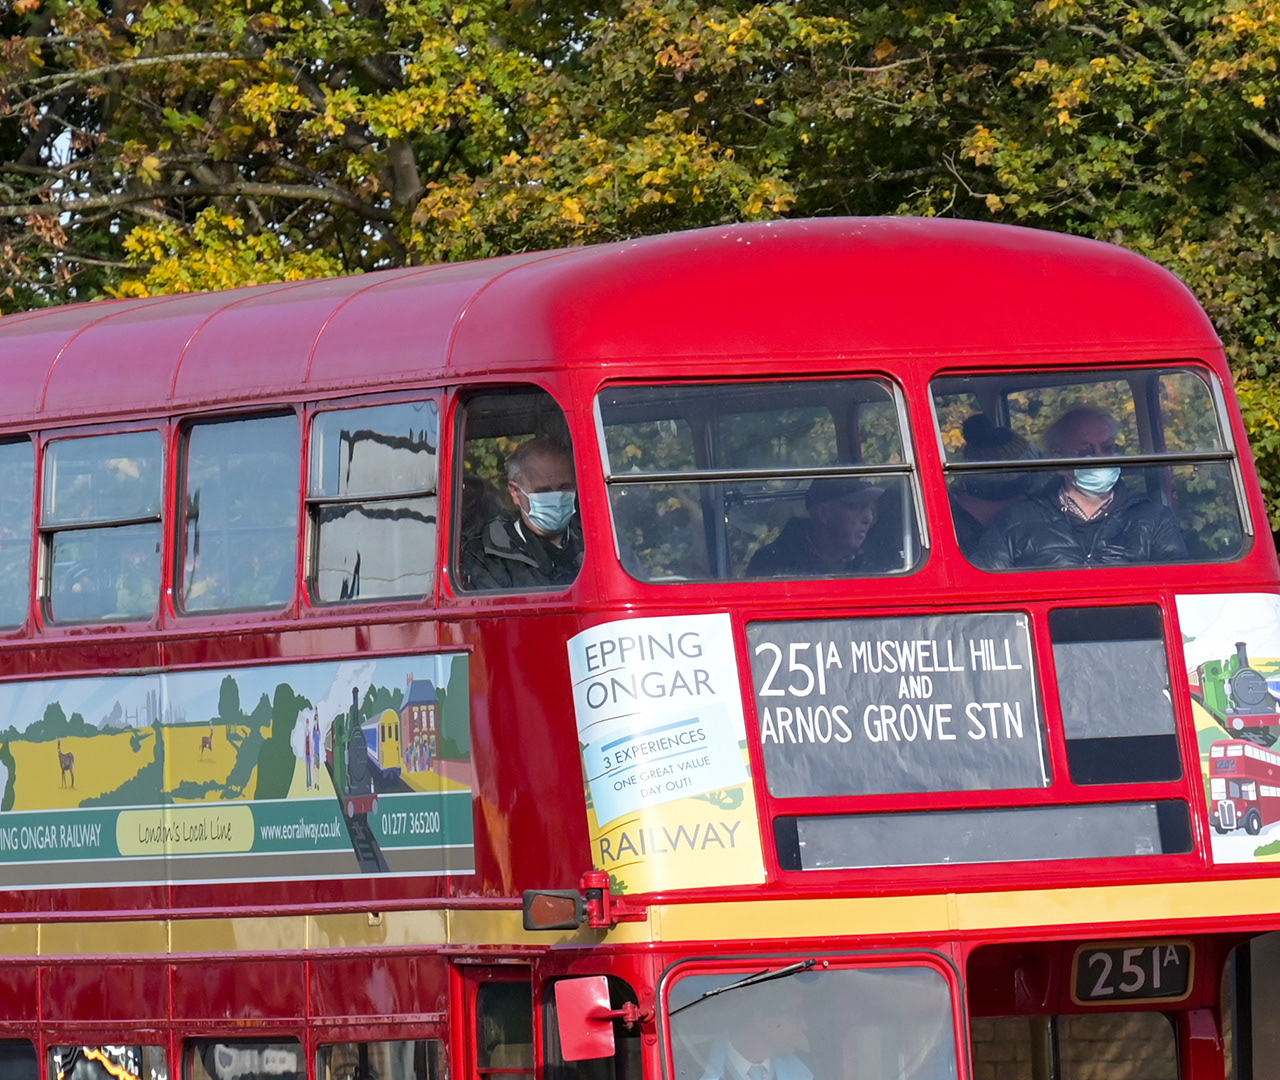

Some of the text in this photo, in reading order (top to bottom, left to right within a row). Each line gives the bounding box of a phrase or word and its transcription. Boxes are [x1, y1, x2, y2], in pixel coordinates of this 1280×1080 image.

[585, 632, 702, 673] EPPING
[851, 640, 964, 673] MUSWELL
[969, 638, 1022, 671] HILL
[586, 669, 716, 709] ONGAR
[898, 675, 933, 699] AND
[761, 702, 1023, 744] ARNOS GROVE STN
[603, 728, 706, 769] 3 EXPERIENCES
[614, 756, 711, 791] ONE GREAT VALUE
[641, 778, 692, 798] DAY OUT!
[21, 825, 58, 849] ONGAR
[60, 824, 101, 848] RAILWAY
[138, 816, 232, 844] London's Local Line
[260, 816, 341, 845] www.eorailway.co.uk
[382, 811, 440, 835] 01277 365200
[600, 821, 741, 865] RAILWAY
